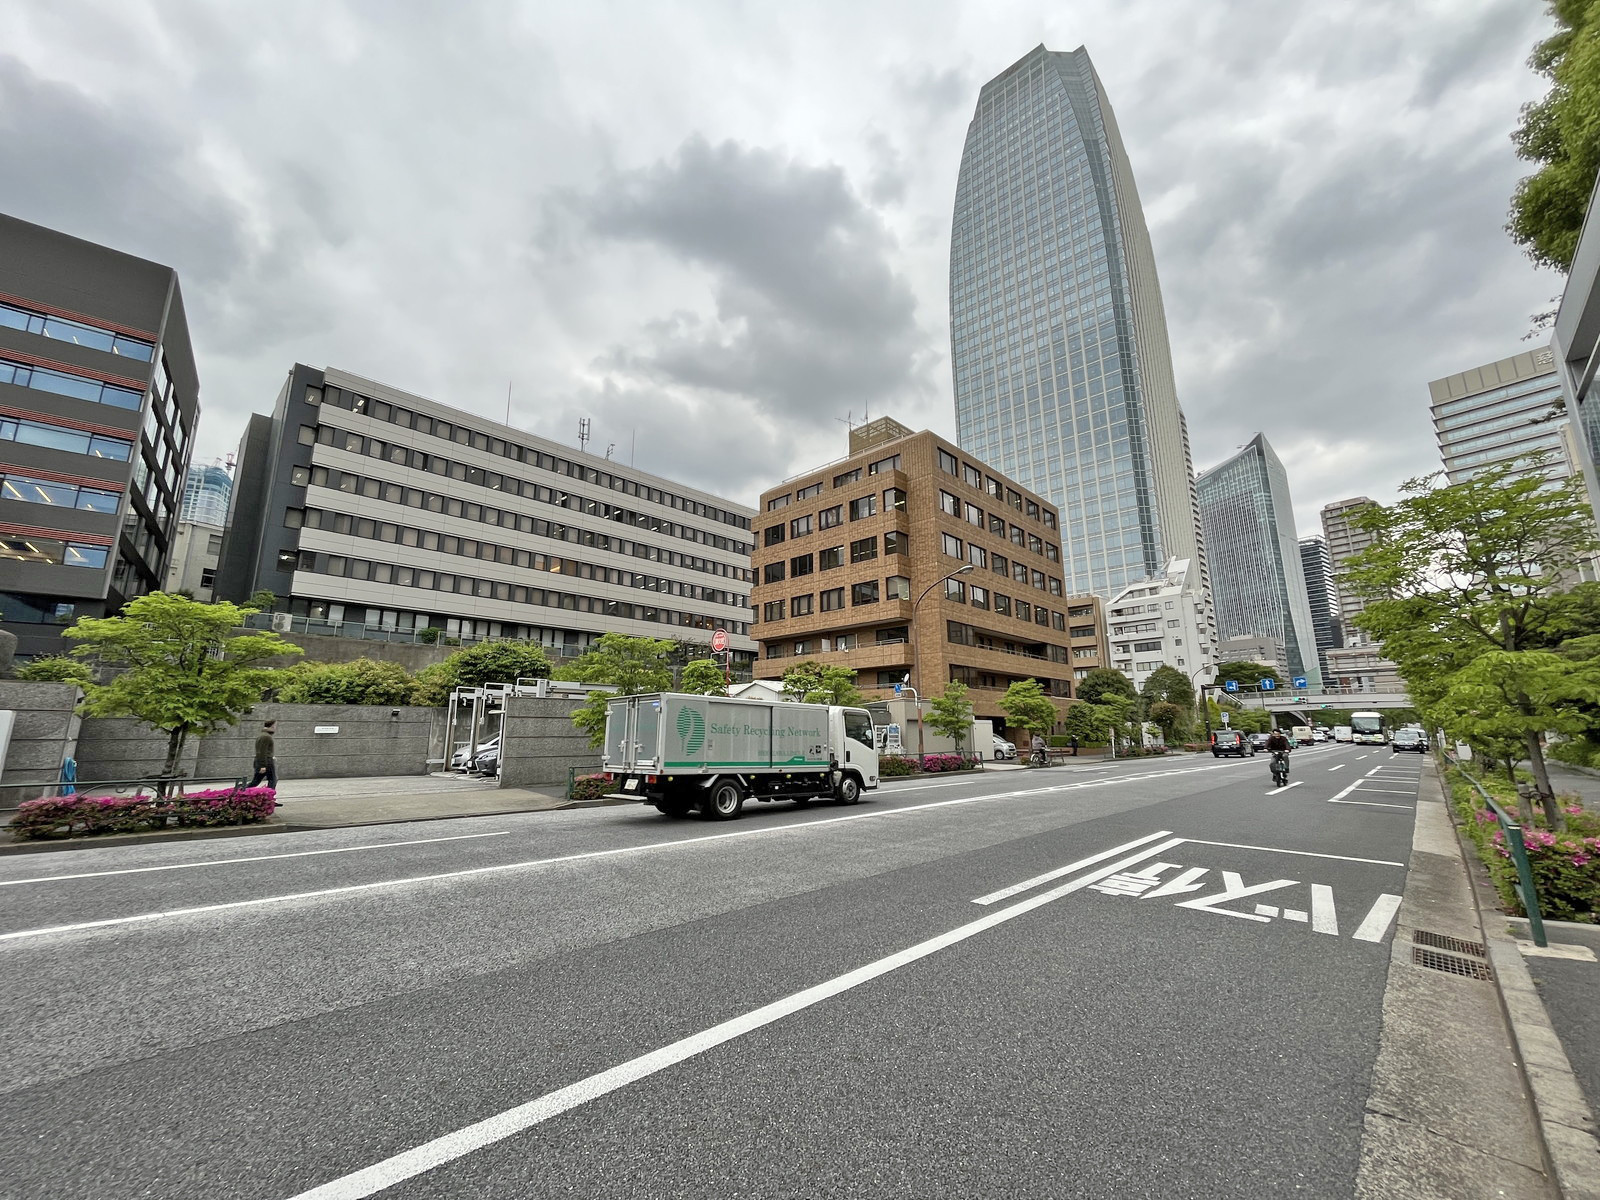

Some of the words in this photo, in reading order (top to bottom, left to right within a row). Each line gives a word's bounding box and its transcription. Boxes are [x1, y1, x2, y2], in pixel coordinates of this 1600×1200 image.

[710, 722, 741, 737] Safety
[787, 726, 821, 738] Network
[1088, 862, 1402, 943] バス停
